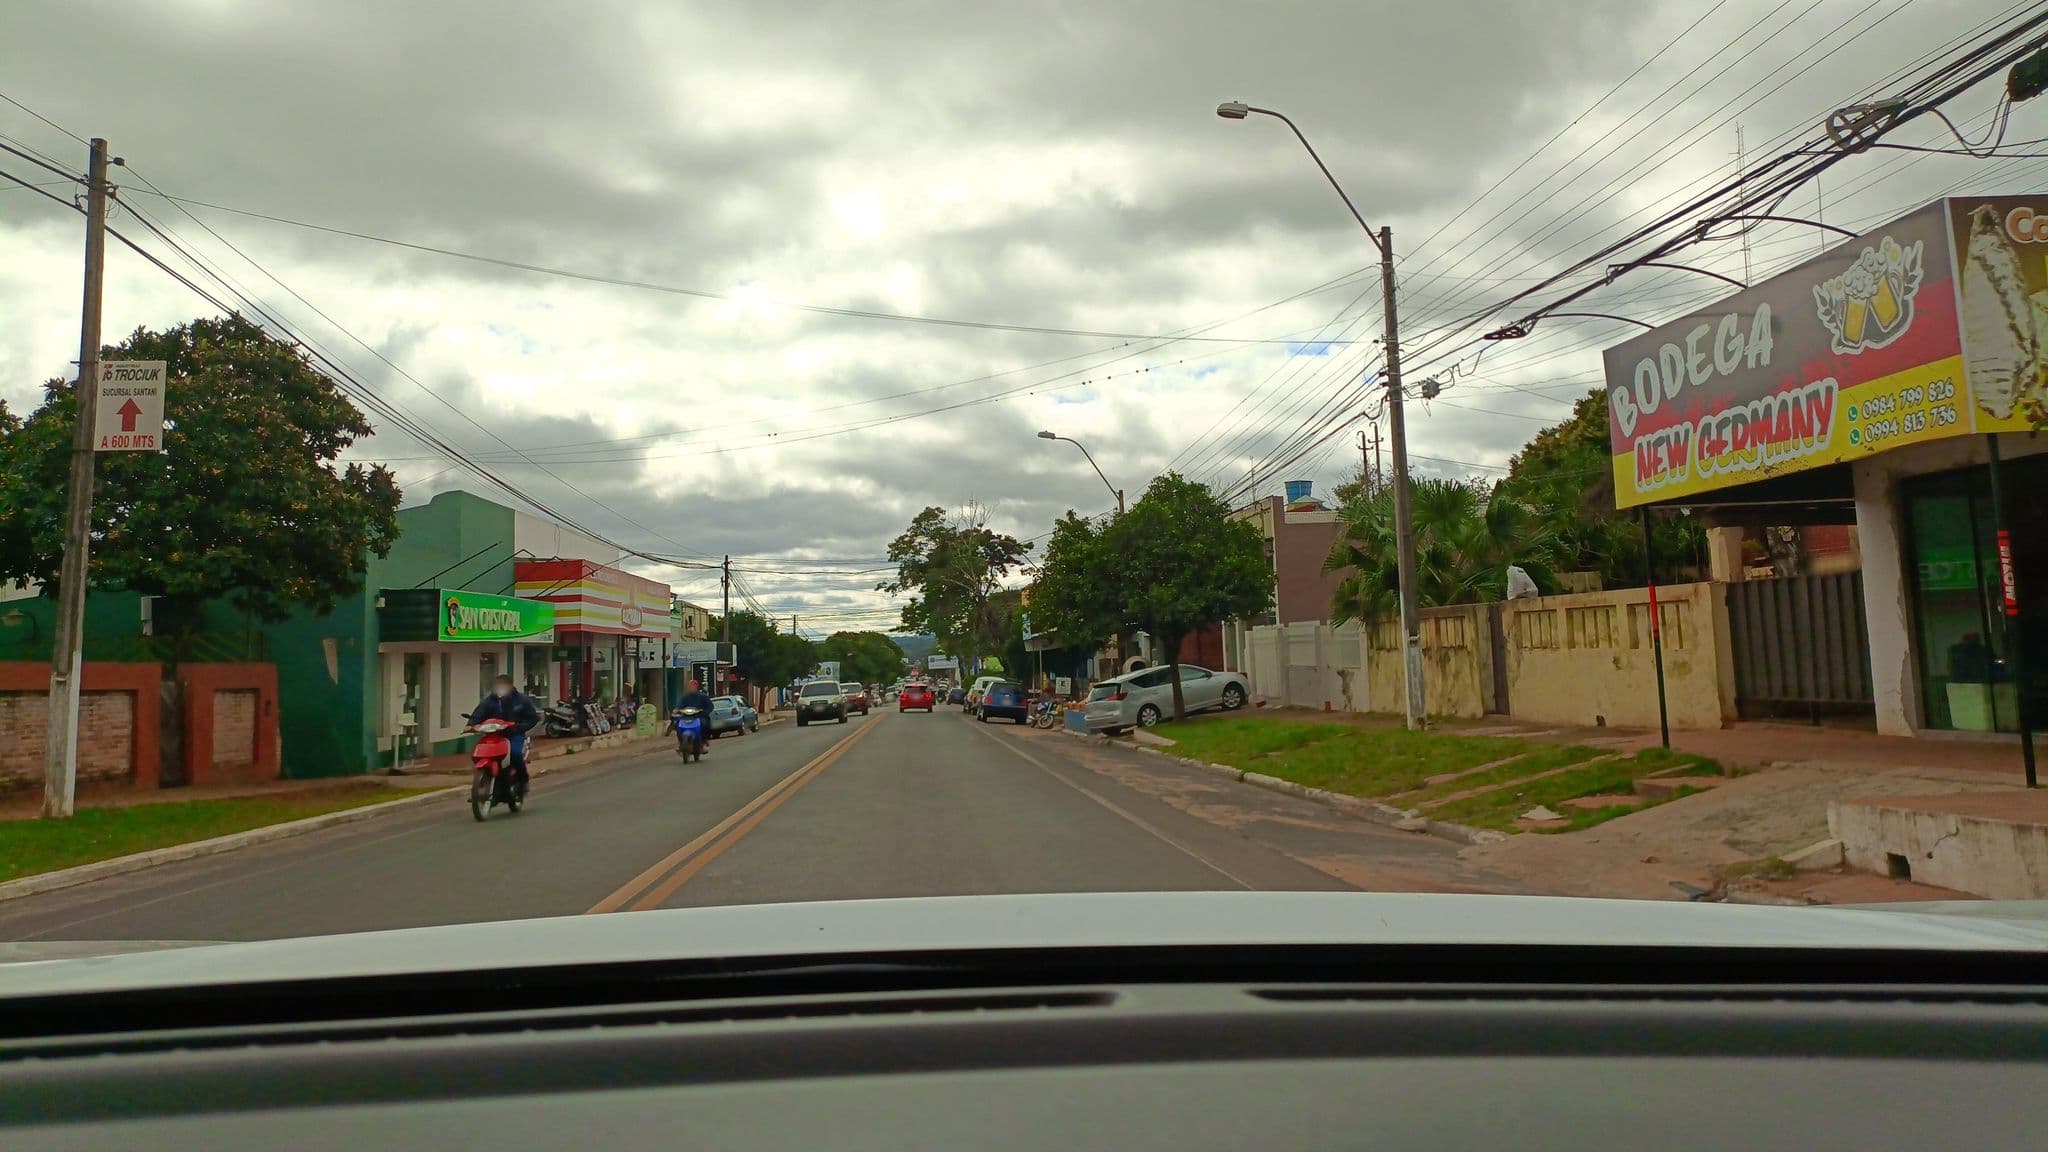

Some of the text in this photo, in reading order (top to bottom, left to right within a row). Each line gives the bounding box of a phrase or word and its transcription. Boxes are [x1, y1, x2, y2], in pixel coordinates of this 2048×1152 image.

[115, 368, 161, 381] TROCIUK
[1612, 303, 1773, 437] BODEGA
[102, 387, 131, 396] SUCURSAL
[1862, 377, 1955, 420] 0984 799 826
[101, 434, 154, 448] A 600 MTS
[1634, 377, 1839, 492] NEW GERMANY
[1864, 417, 1899, 443] 0994
[1903, 410, 1925, 434] 813
[459, 605, 479, 630] SAN
